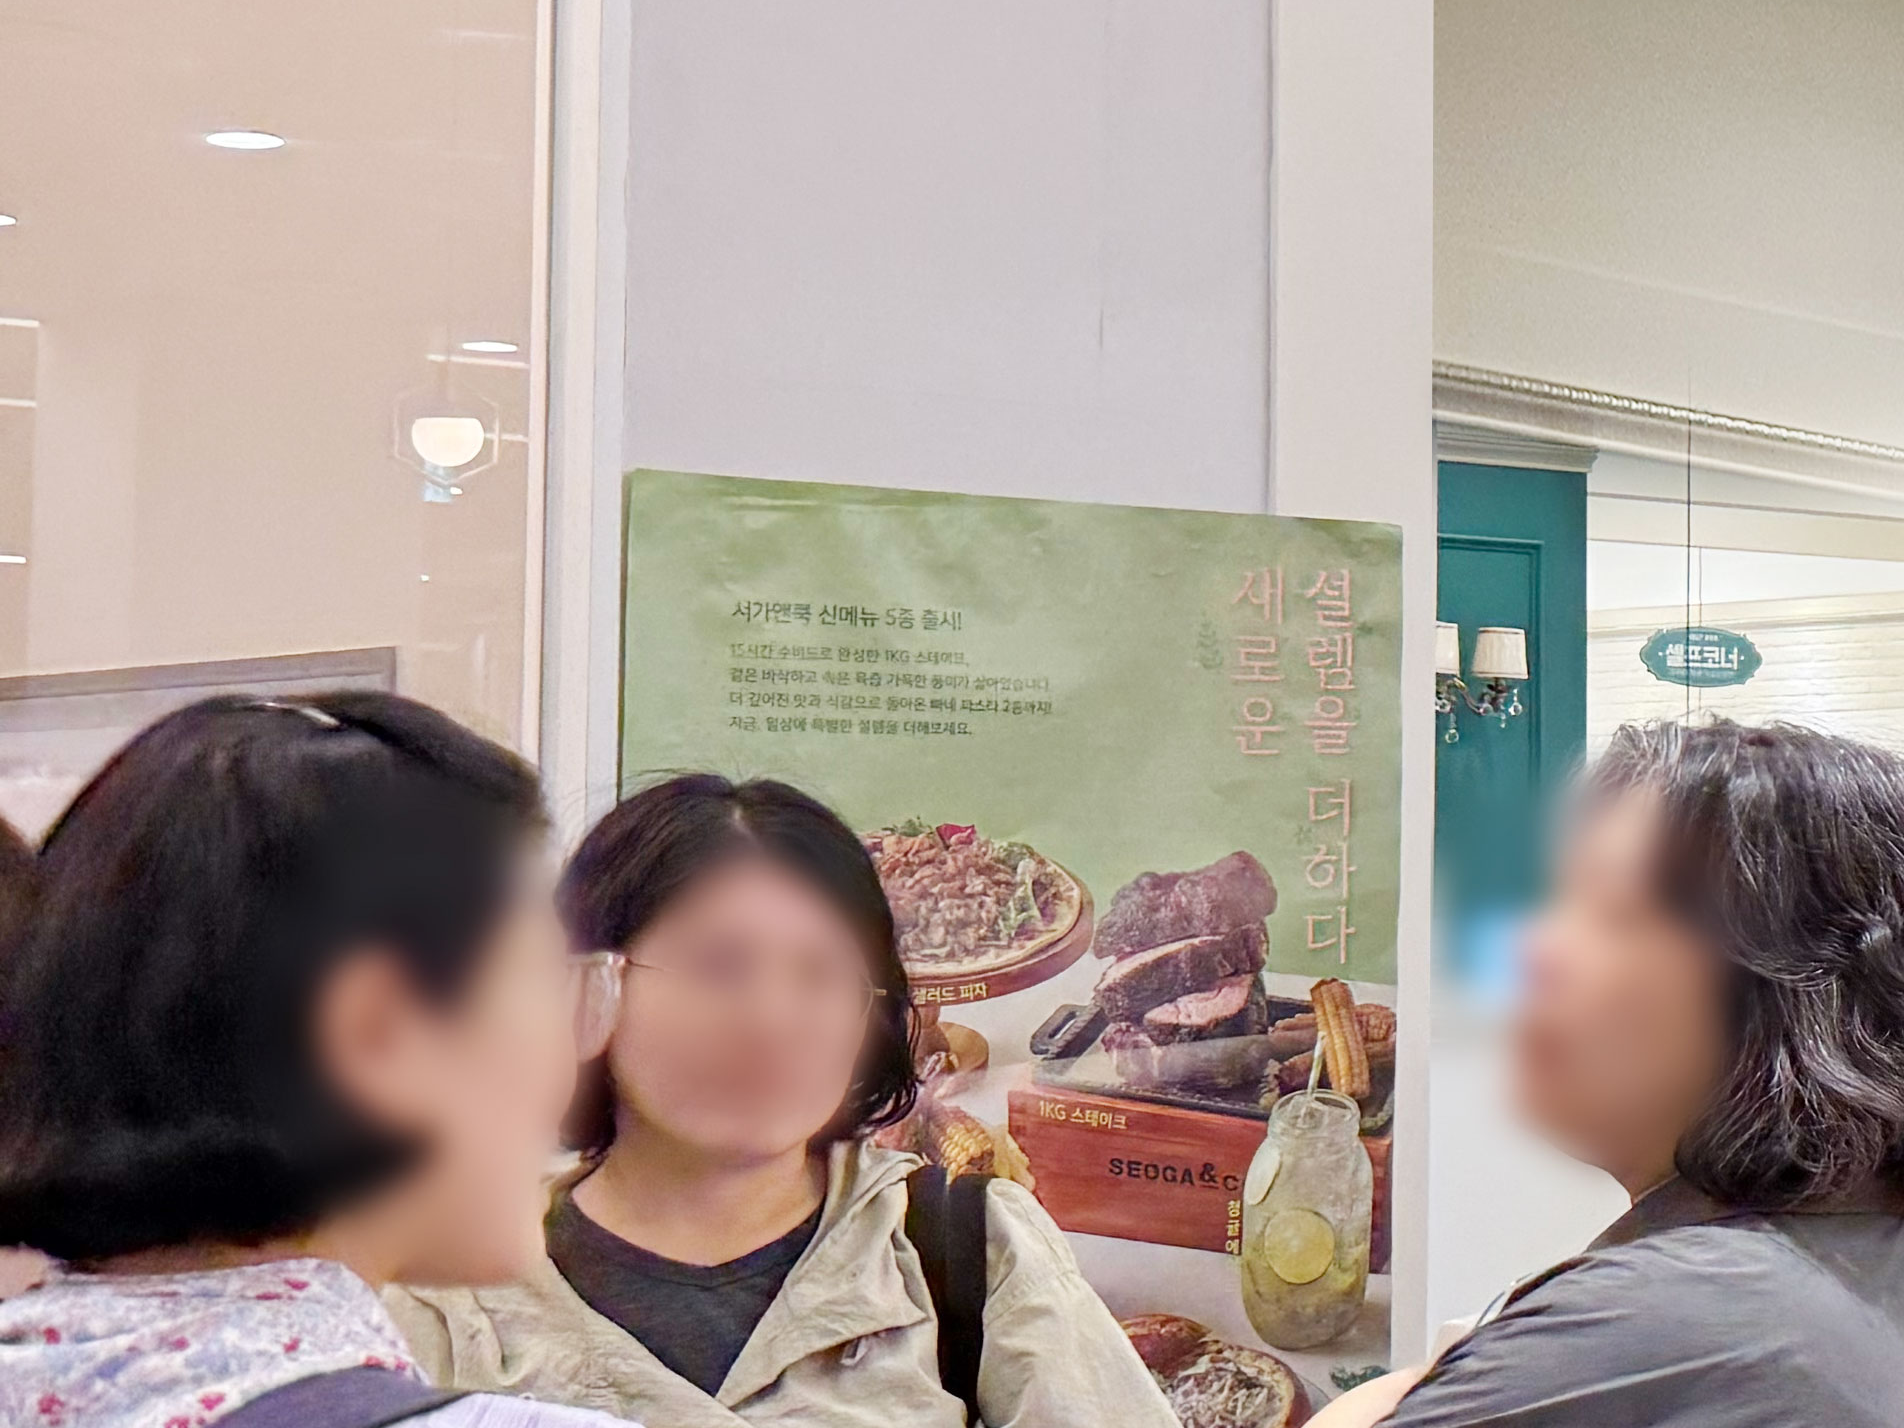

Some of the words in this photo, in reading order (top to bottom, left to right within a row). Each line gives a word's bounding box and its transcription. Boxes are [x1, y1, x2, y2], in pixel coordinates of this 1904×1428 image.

[731, 601, 812, 625] 서가앤쿡
[818, 604, 880, 627] 신메뉴
[885, 608, 915, 630] 5종
[921, 609, 962, 631] 출시!
[1230, 565, 1286, 755] 새로운
[1303, 567, 1357, 755] 설렘을
[729, 691, 743, 706] 더
[1304, 778, 1357, 965] 더하다
[960, 982, 988, 1001] 피자
[1039, 1100, 1066, 1121] 1KG
[1070, 1108, 1128, 1130] 스테이크
